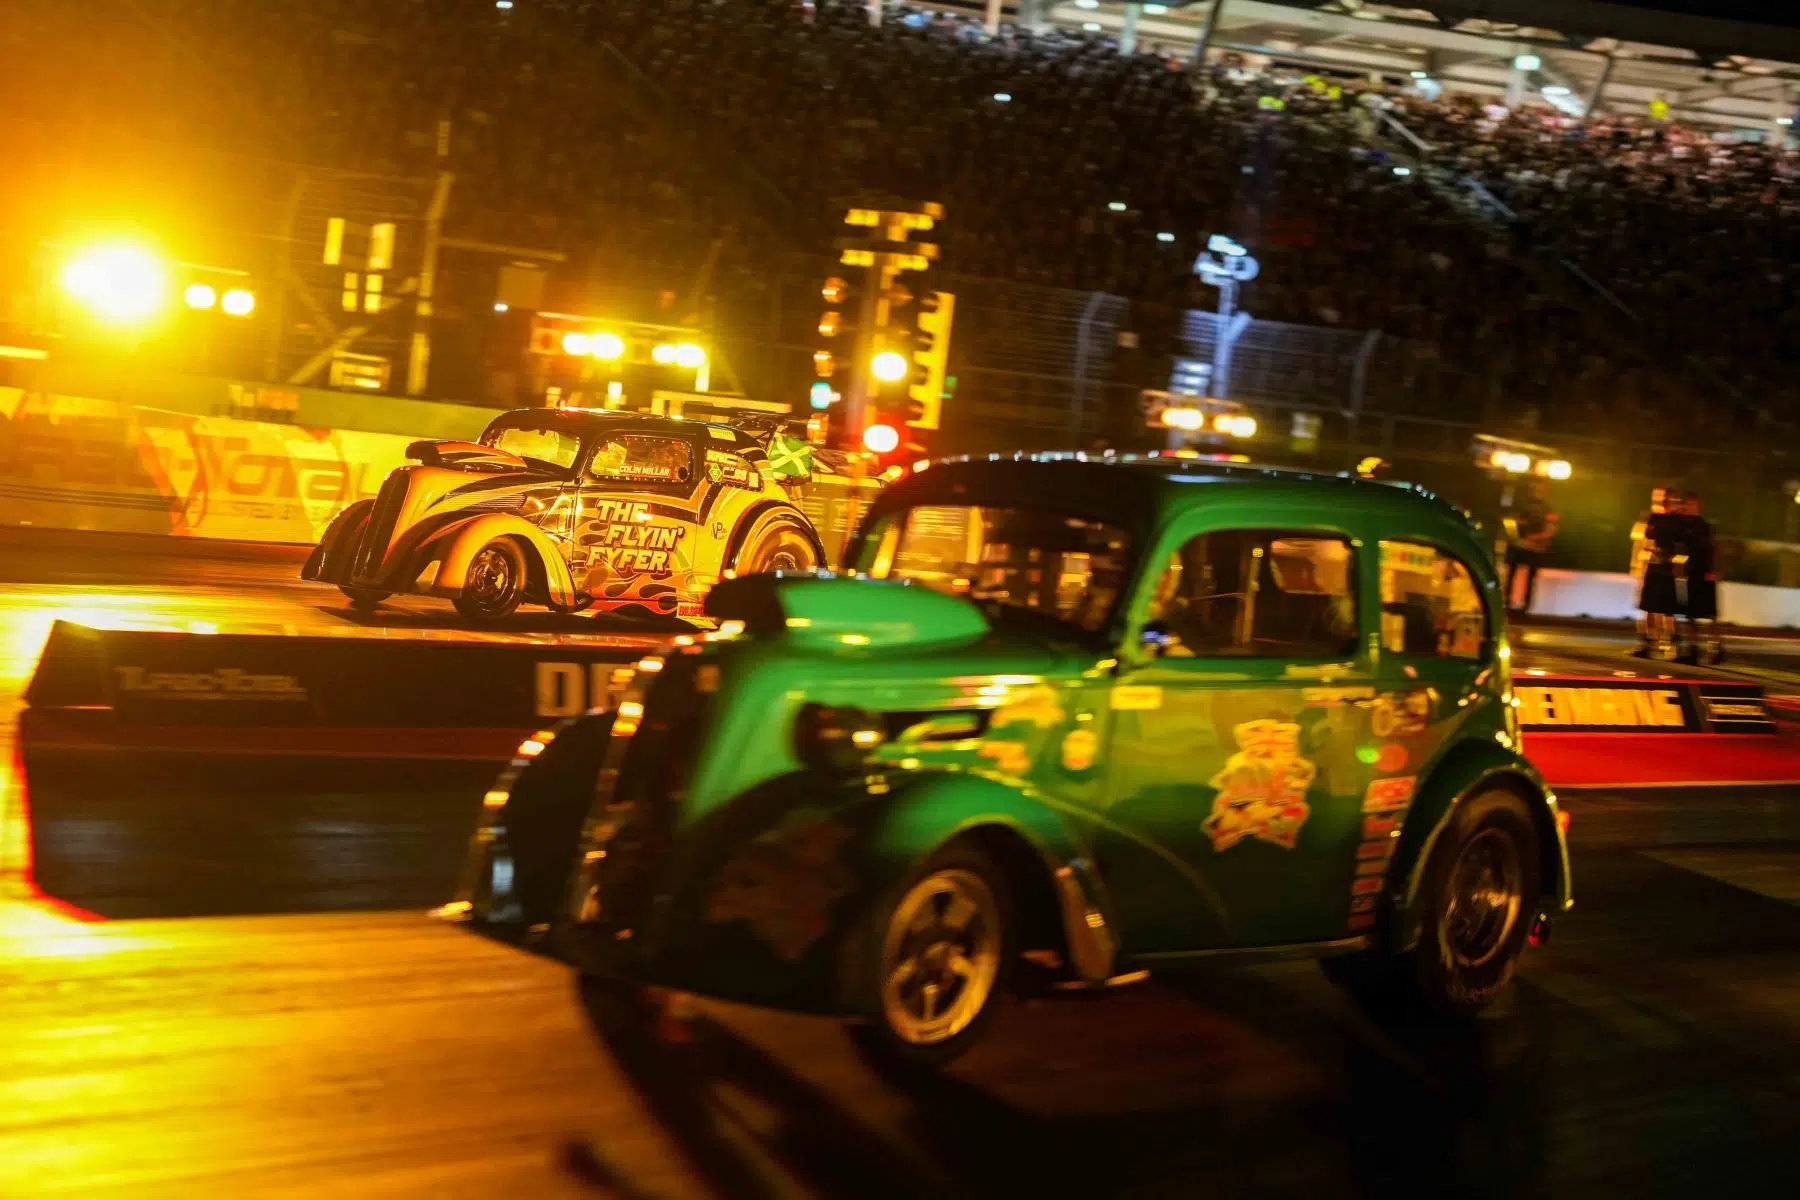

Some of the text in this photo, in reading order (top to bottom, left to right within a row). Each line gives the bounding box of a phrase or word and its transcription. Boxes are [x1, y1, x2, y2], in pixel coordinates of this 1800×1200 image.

[597, 500, 651, 523] THE
[605, 525, 684, 550] FLYIN'
[586, 546, 668, 573] FYFER
